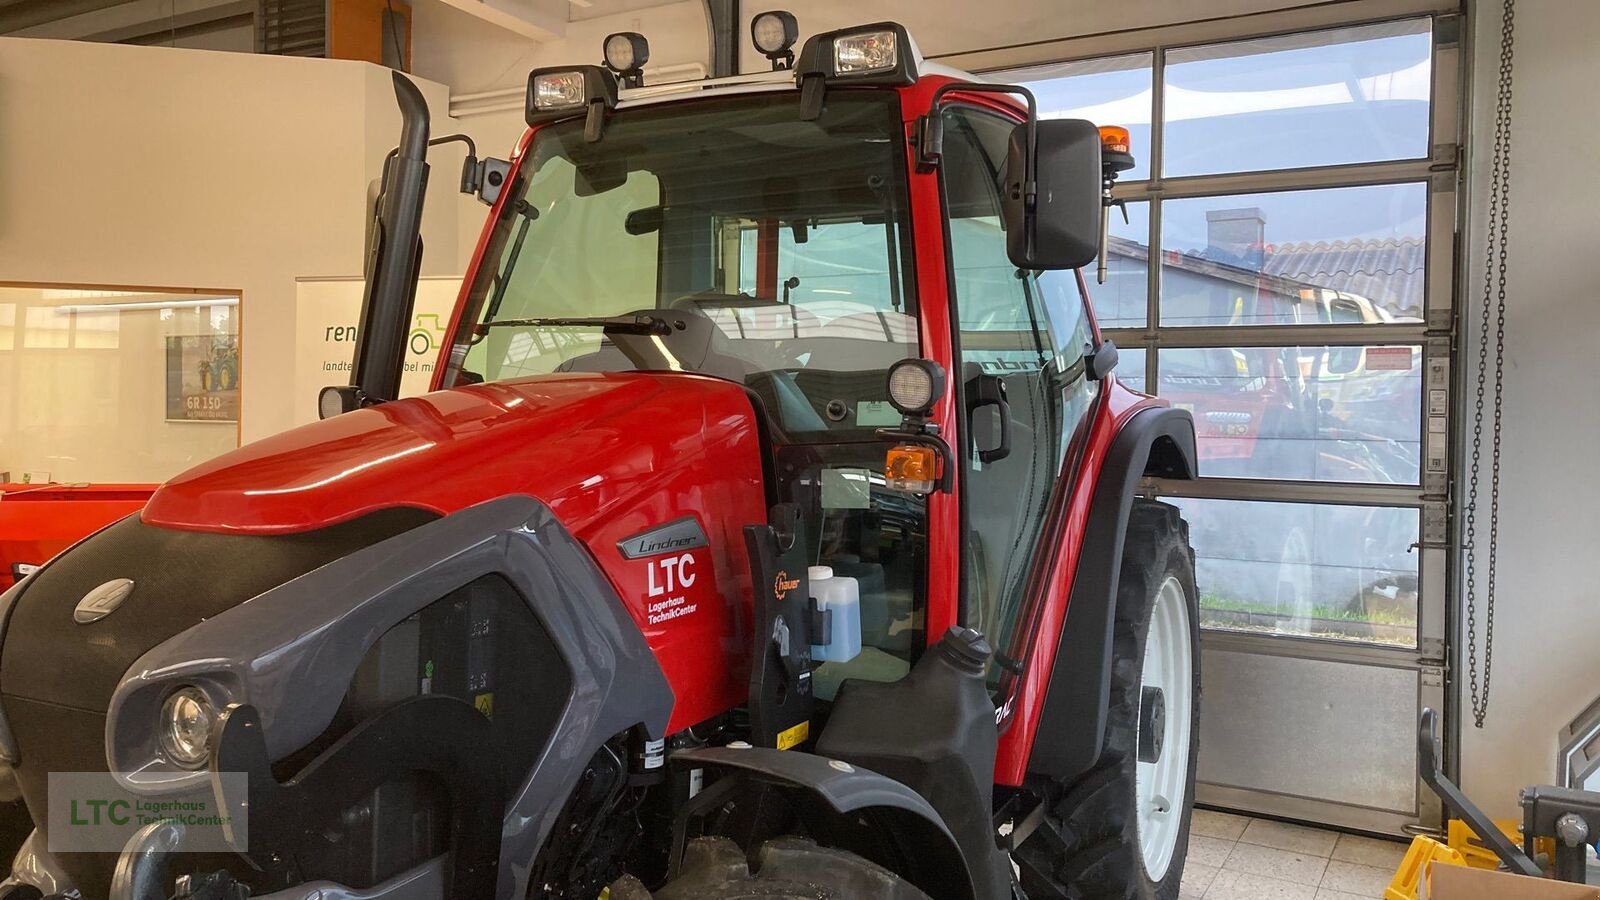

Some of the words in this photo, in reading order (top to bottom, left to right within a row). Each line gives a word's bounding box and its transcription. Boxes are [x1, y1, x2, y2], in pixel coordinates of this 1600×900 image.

[325, 325, 357, 342] ren
[322, 361, 352, 371] landte
[404, 361, 418, 372] bel
[421, 361, 434, 372] mi
[203, 396, 221, 409] 150
[639, 536, 697, 553] Lindner
[647, 553, 696, 598] LTC
[778, 577, 800, 591] hauer
[648, 596, 685, 613] Lagerhaus
[648, 604, 697, 625] TechnikCenter
